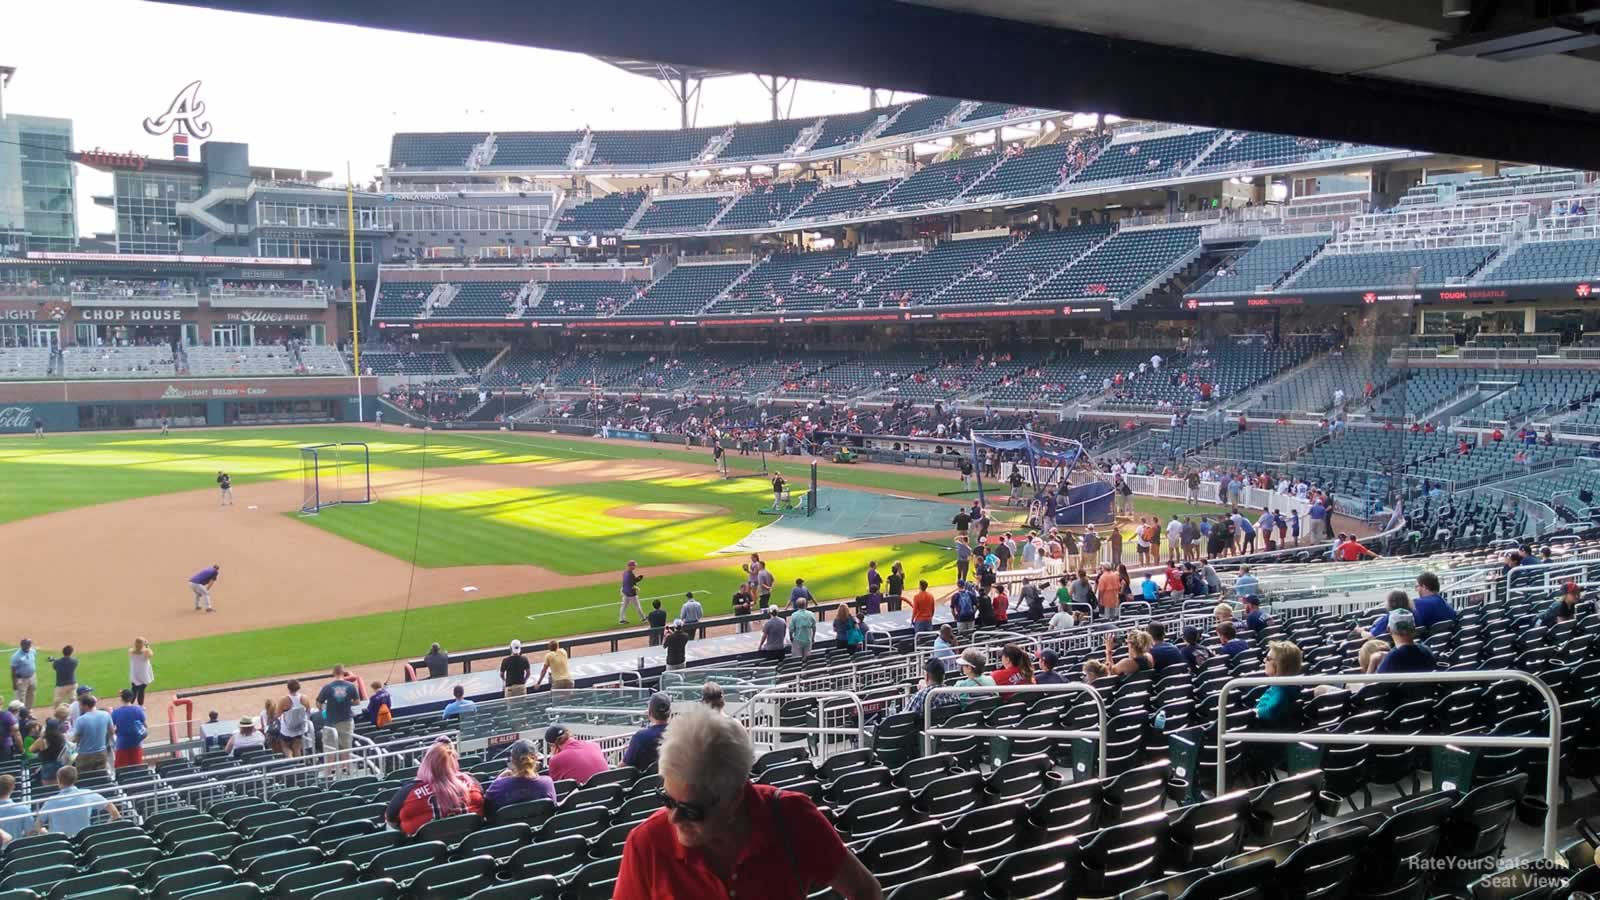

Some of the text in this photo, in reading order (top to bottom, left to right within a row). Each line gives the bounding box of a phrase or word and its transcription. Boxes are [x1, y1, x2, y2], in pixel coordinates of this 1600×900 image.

[601, 237, 617, 245] 6:11
[82, 310, 181, 320] CHOP HOUSE
[241, 310, 283, 321] Silver
